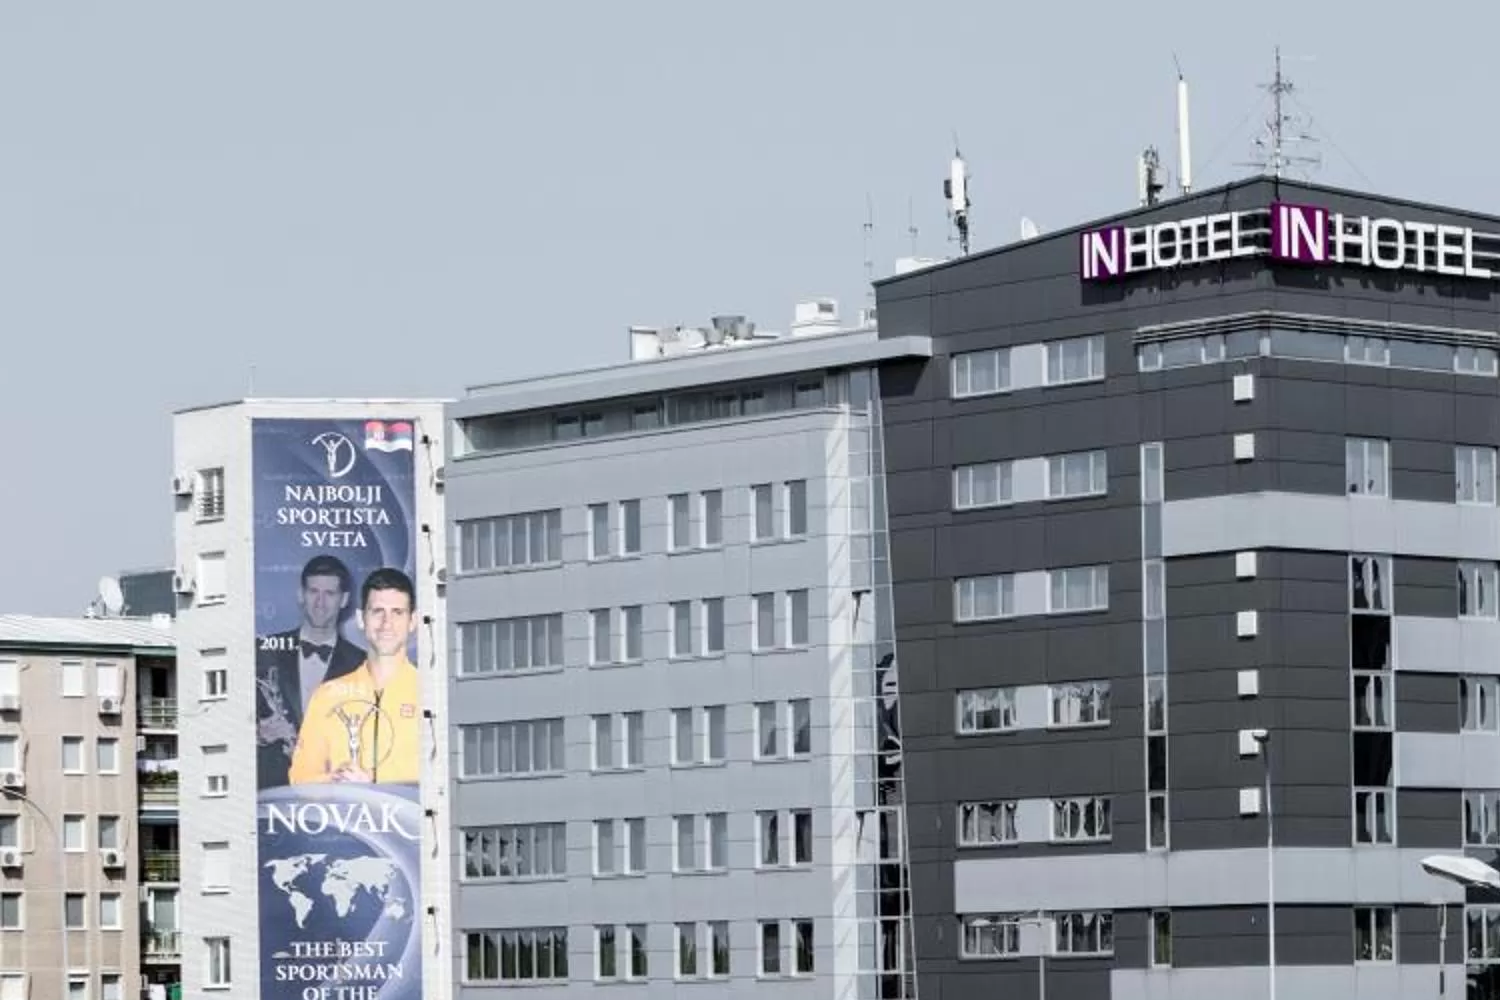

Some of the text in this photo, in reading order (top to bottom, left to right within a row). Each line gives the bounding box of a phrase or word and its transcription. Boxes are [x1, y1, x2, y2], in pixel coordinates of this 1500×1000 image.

[1081, 212, 1257, 280] IN HOTEL
[1279, 205, 1492, 278] IN HOTEL
[285, 485, 381, 505] NAJBOLJI
[277, 507, 391, 528] SPORTISTA
[301, 531, 368, 547] SVETA
[259, 636, 299, 651] 2011.
[267, 803, 424, 840] NOVAK
[291, 940, 388, 957] THE BEST
[275, 963, 404, 981] SPORTSMAN
